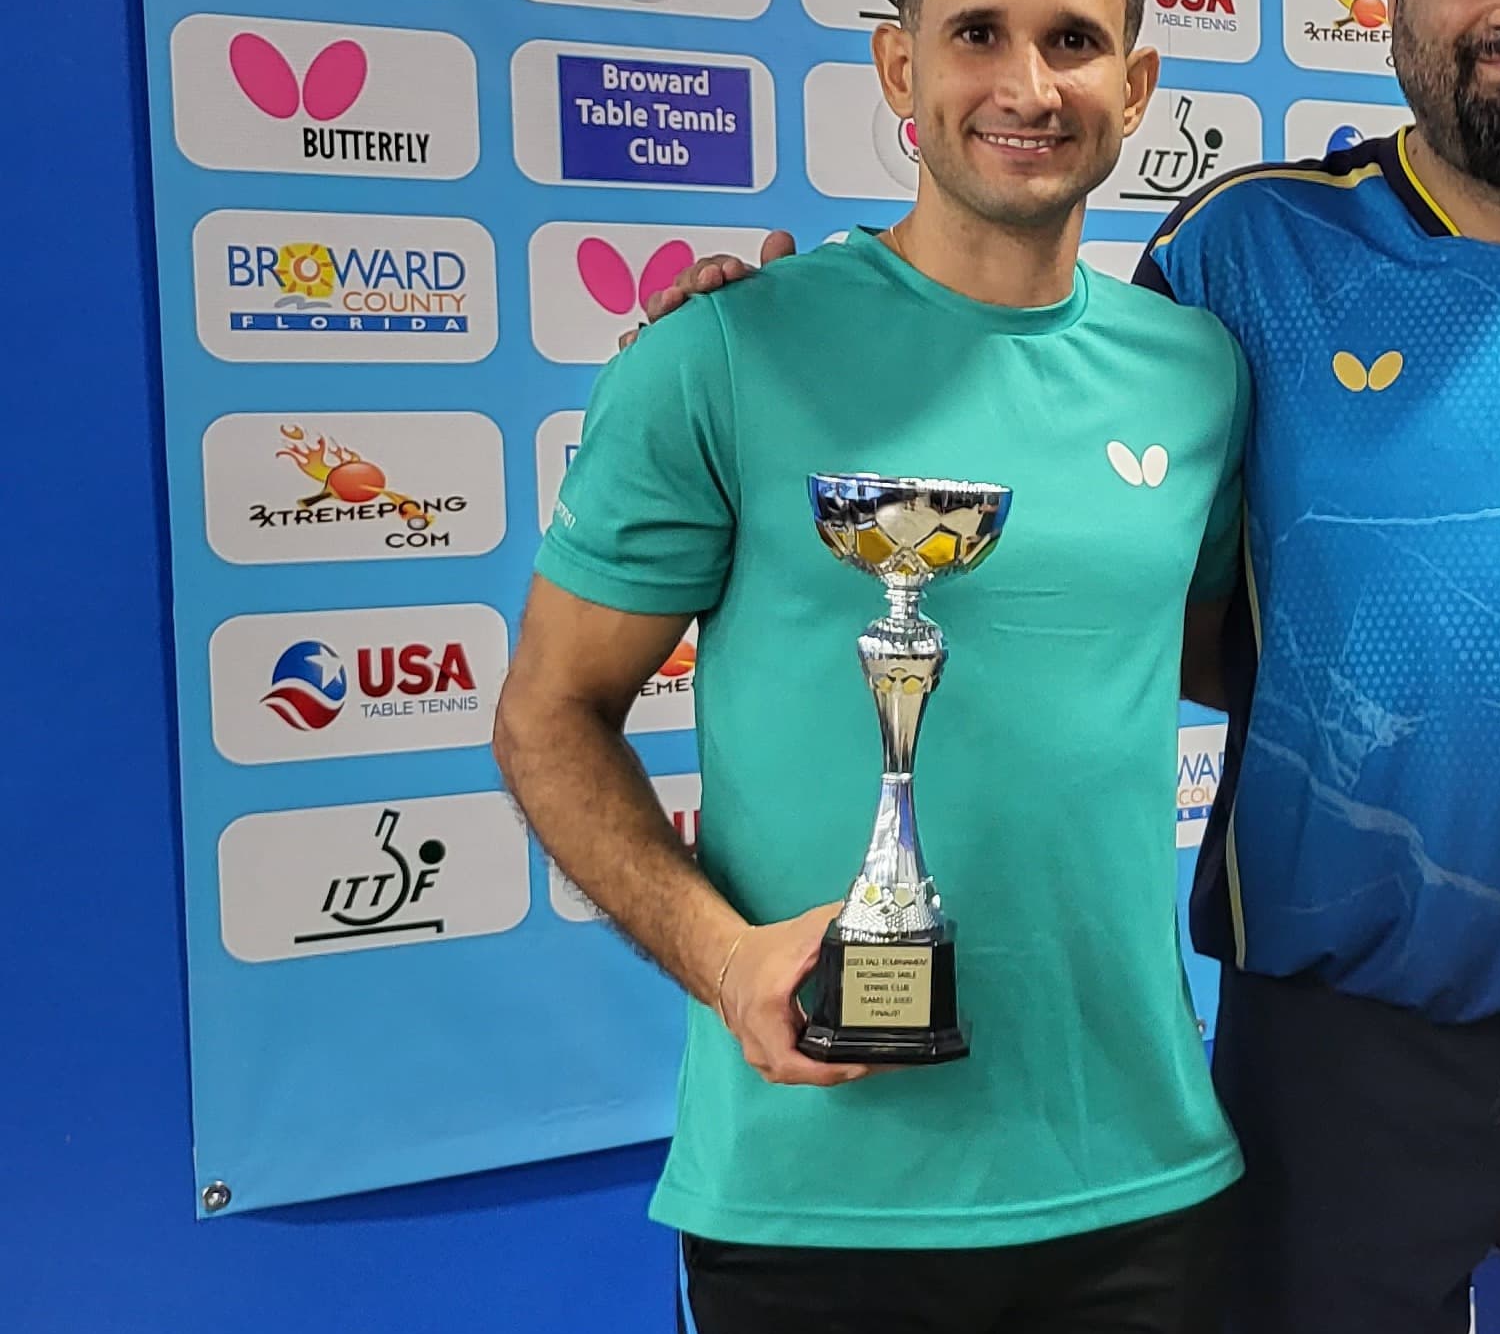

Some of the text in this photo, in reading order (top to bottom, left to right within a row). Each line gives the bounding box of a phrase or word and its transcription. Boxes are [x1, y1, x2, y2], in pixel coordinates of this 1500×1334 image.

[1155, 12, 1237, 33] TABLE TENNIS
[602, 64, 710, 97] Broward
[576, 98, 736, 134] Table Tennis
[303, 127, 430, 164] BUTTERFLY
[628, 138, 689, 167] Club
[228, 244, 466, 291] BROWARD
[343, 291, 466, 313] COUNTY
[242, 317, 460, 330] FLORIDA
[385, 532, 450, 548] COM
[357, 642, 476, 699] USA
[360, 695, 478, 718] TABLE TENNIS
